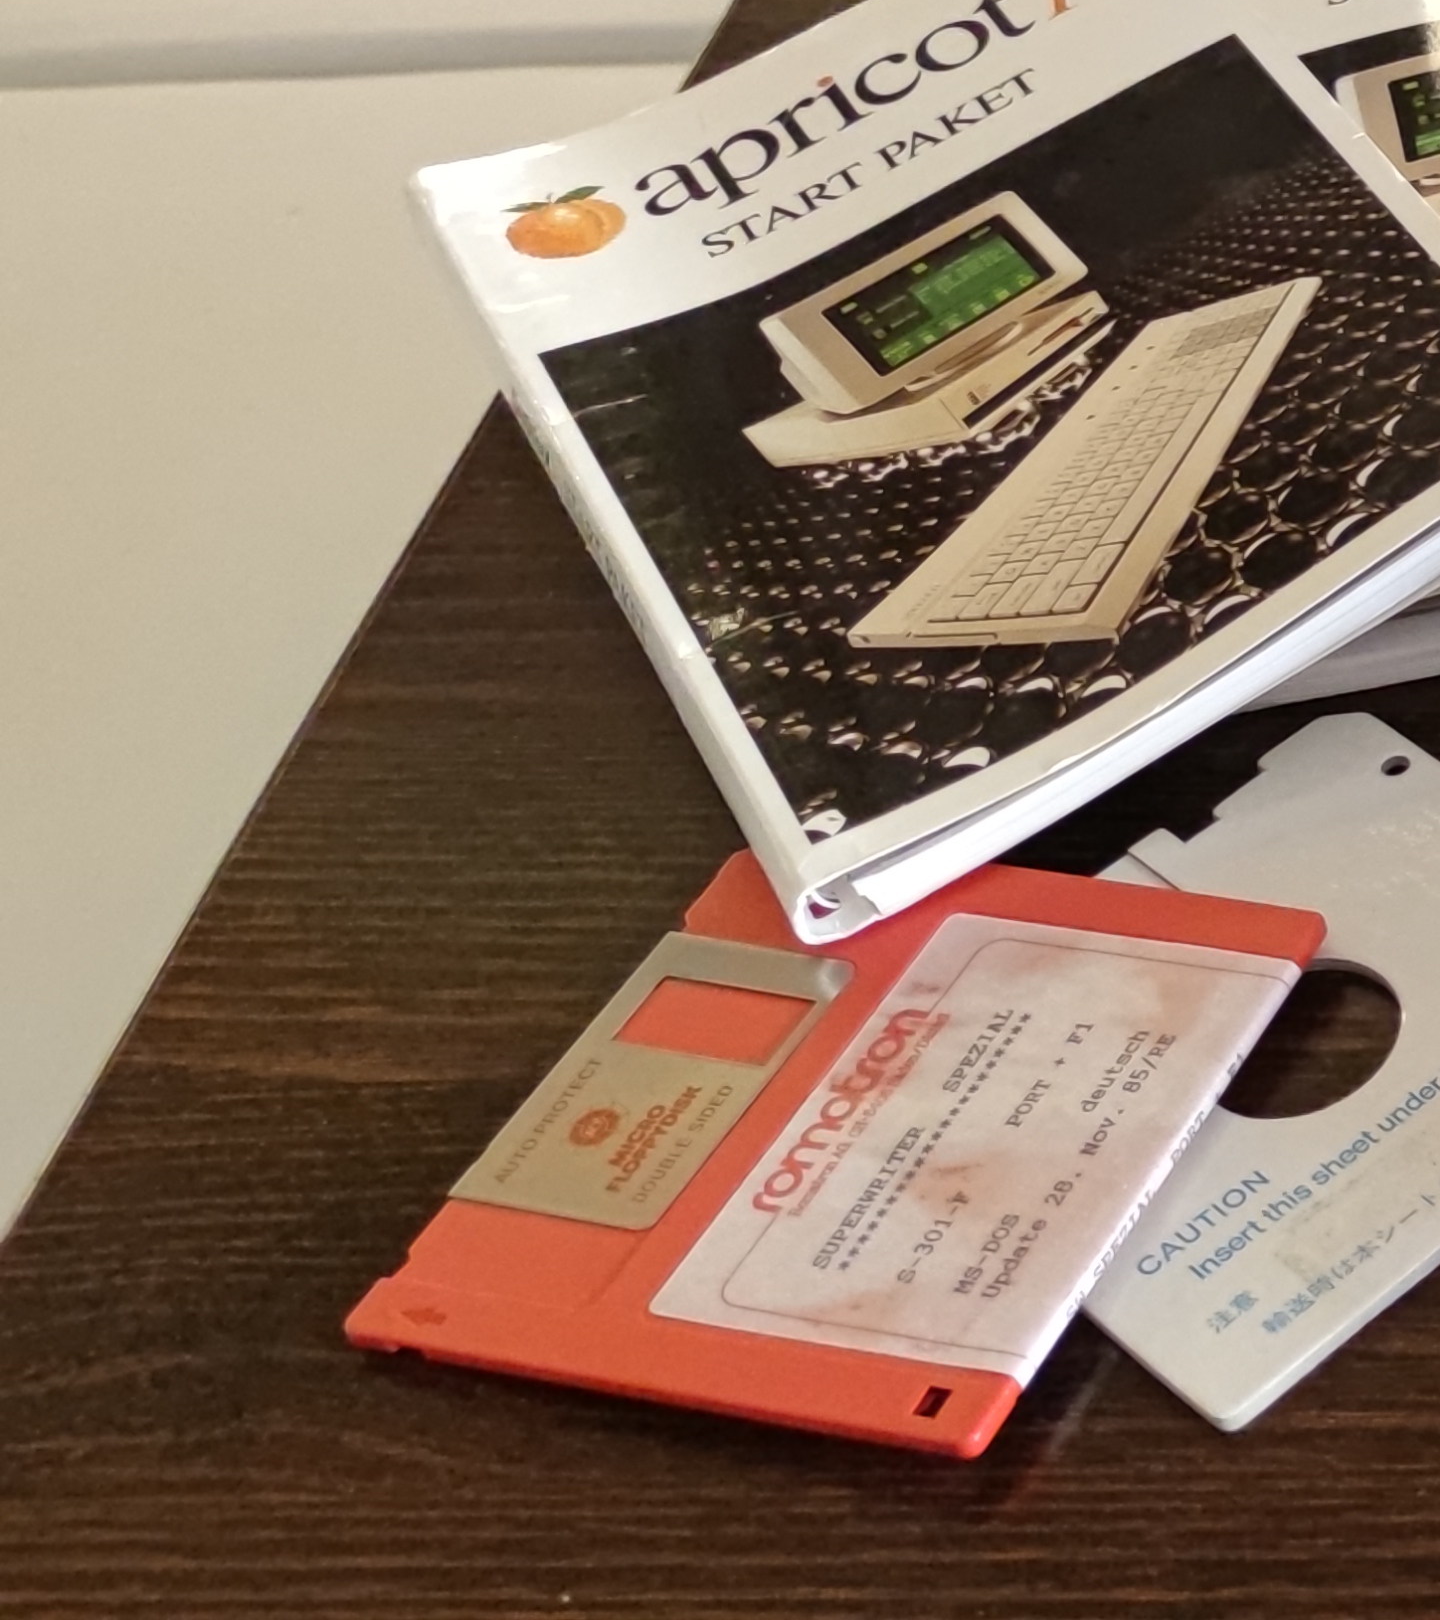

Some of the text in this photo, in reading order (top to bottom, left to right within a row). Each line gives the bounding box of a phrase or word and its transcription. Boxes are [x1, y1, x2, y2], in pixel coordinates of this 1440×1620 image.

[699, 67, 1038, 260] START PAKET
[493, 1137, 538, 1184] AUTO
[533, 1058, 602, 1135] PROTECT
[607, 1103, 667, 1168] MICRO
[752, 1008, 934, 1214] romatron
[1004, 1078, 1051, 1128] PORT
[1065, 1021, 1095, 1045] F1
[605, 1085, 702, 1193] FLOPPYDISK
[632, 1085, 733, 1204] DOUBLE SIDED
[812, 1008, 1014, 1270] SUPERWRITER SPEZIAL
[953, 1030, 1150, 1295] MS-DOS deutsch
[981, 1218, 1048, 1299] Update
[1079, 1109, 1125, 1157] Nov.
[1122, 1033, 1178, 1094] 85/RE
[1136, 1169, 1271, 1277] CAUTION
[1187, 1221, 1268, 1281] Insert
[1260, 1183, 1314, 1224] this
[1311, 1128, 1381, 1187] sheet
[1206, 1288, 1261, 1334] 注意
